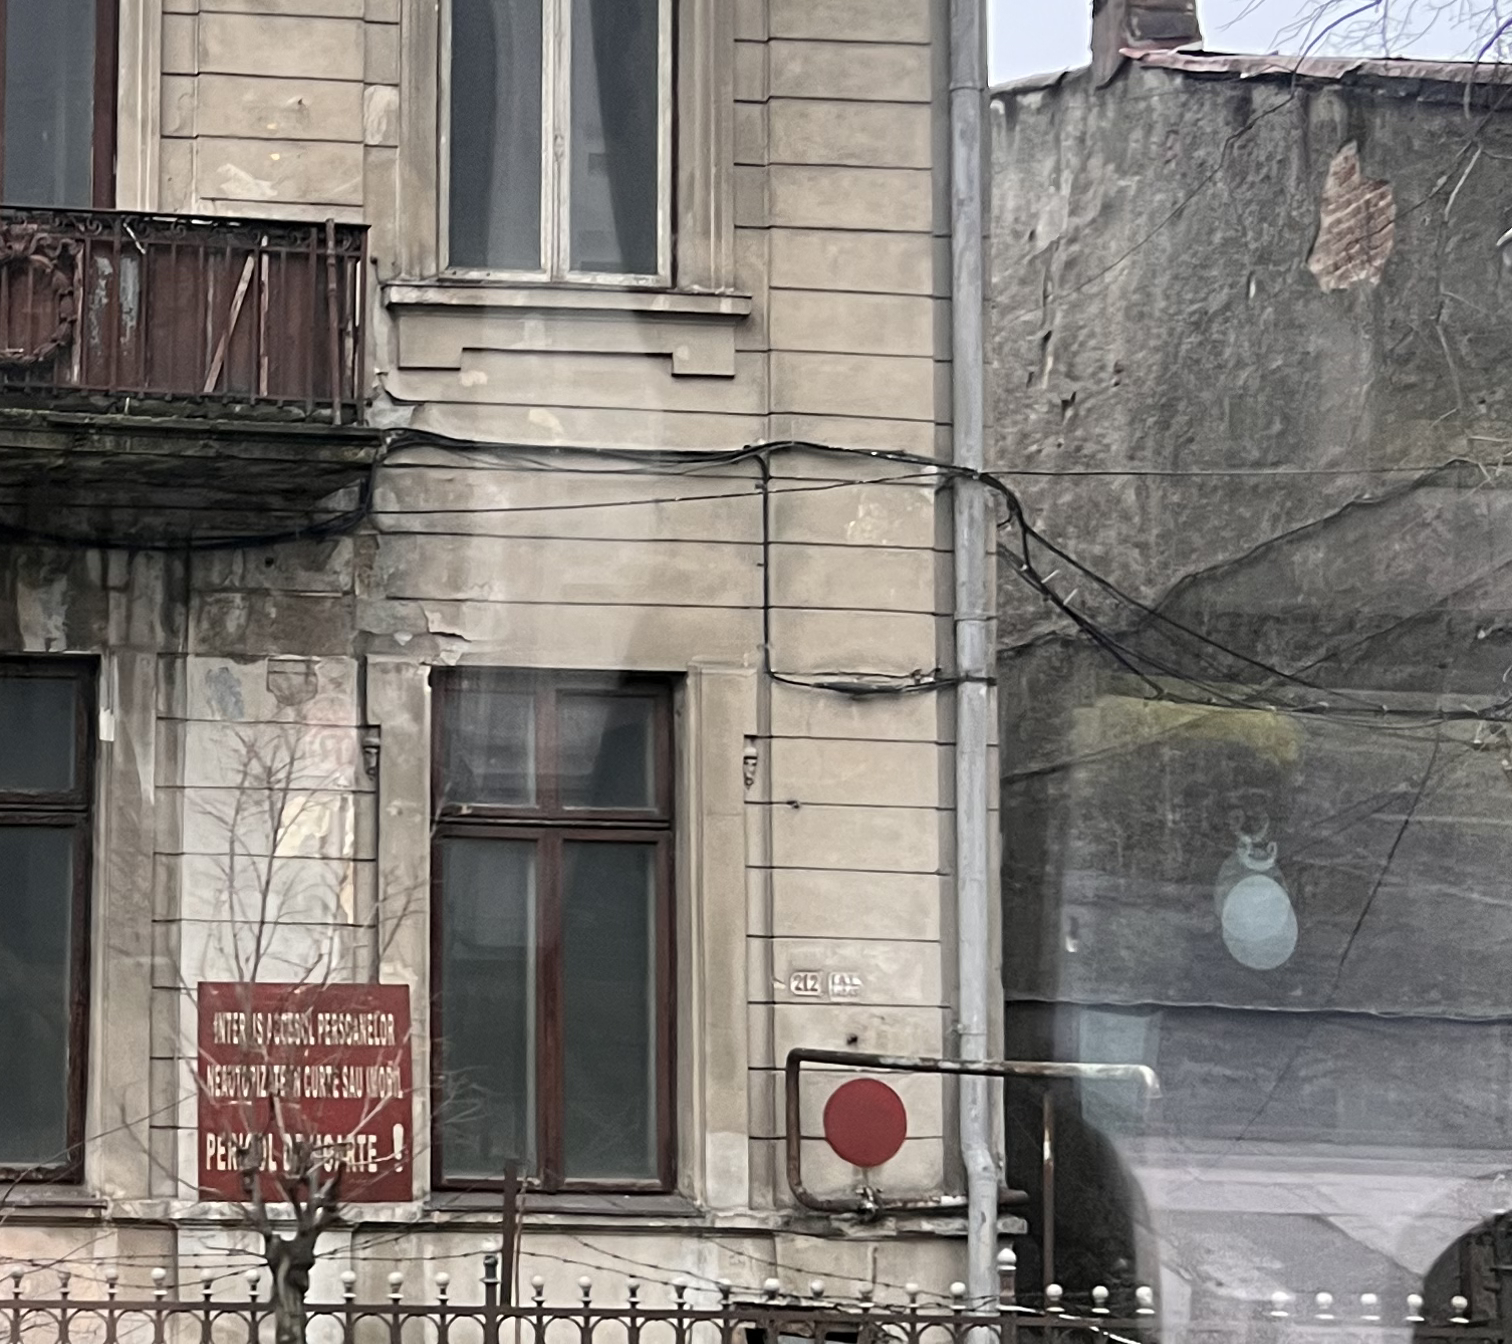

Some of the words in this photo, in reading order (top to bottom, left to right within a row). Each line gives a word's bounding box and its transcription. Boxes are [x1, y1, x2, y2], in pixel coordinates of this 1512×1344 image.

[793, 973, 819, 992] 212
[213, 1012, 263, 1045] INTERIS
[317, 1013, 396, 1047] PERSOANELOR
[303, 1065, 340, 1099] CURTE
[341, 1065, 364, 1099] SAU
[283, 1133, 308, 1172] D
